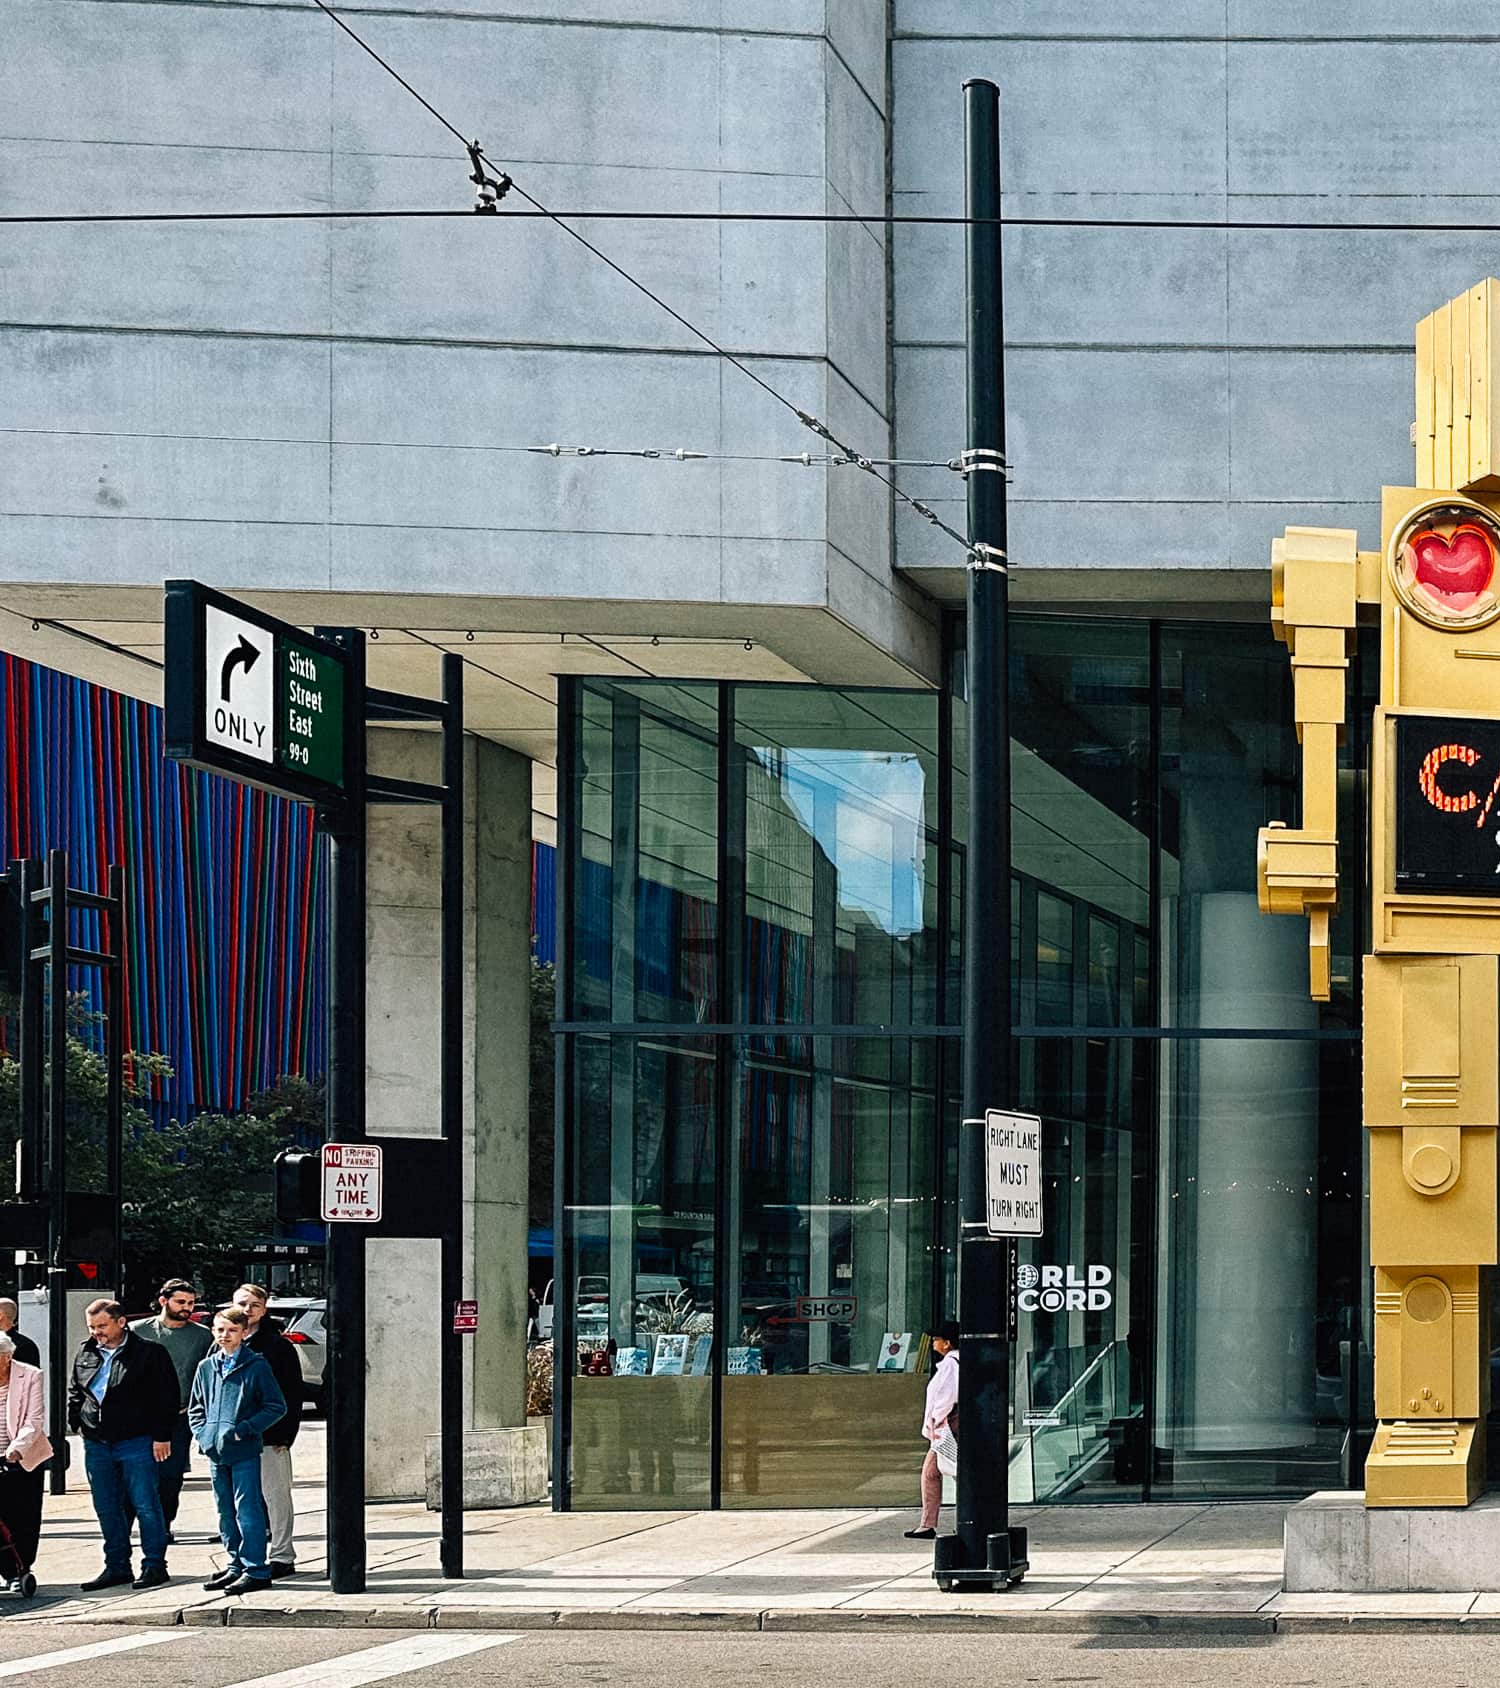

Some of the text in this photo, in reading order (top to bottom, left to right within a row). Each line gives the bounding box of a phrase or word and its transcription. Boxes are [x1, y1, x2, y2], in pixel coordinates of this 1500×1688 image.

[289, 651, 317, 682] Sixth
[289, 680, 323, 714] Street
[215, 708, 266, 748] ONLY
[289, 709, 313, 739] East
[990, 1127, 1038, 1151] RIGHT LANE
[325, 1149, 341, 1165] NO
[336, 1172, 369, 1187] ANY
[1000, 1162, 1028, 1185] MUST
[335, 1189, 369, 1205] TIME
[991, 1199, 1038, 1219] TURN RIGHT
[802, 1303, 853, 1316] SHOP
